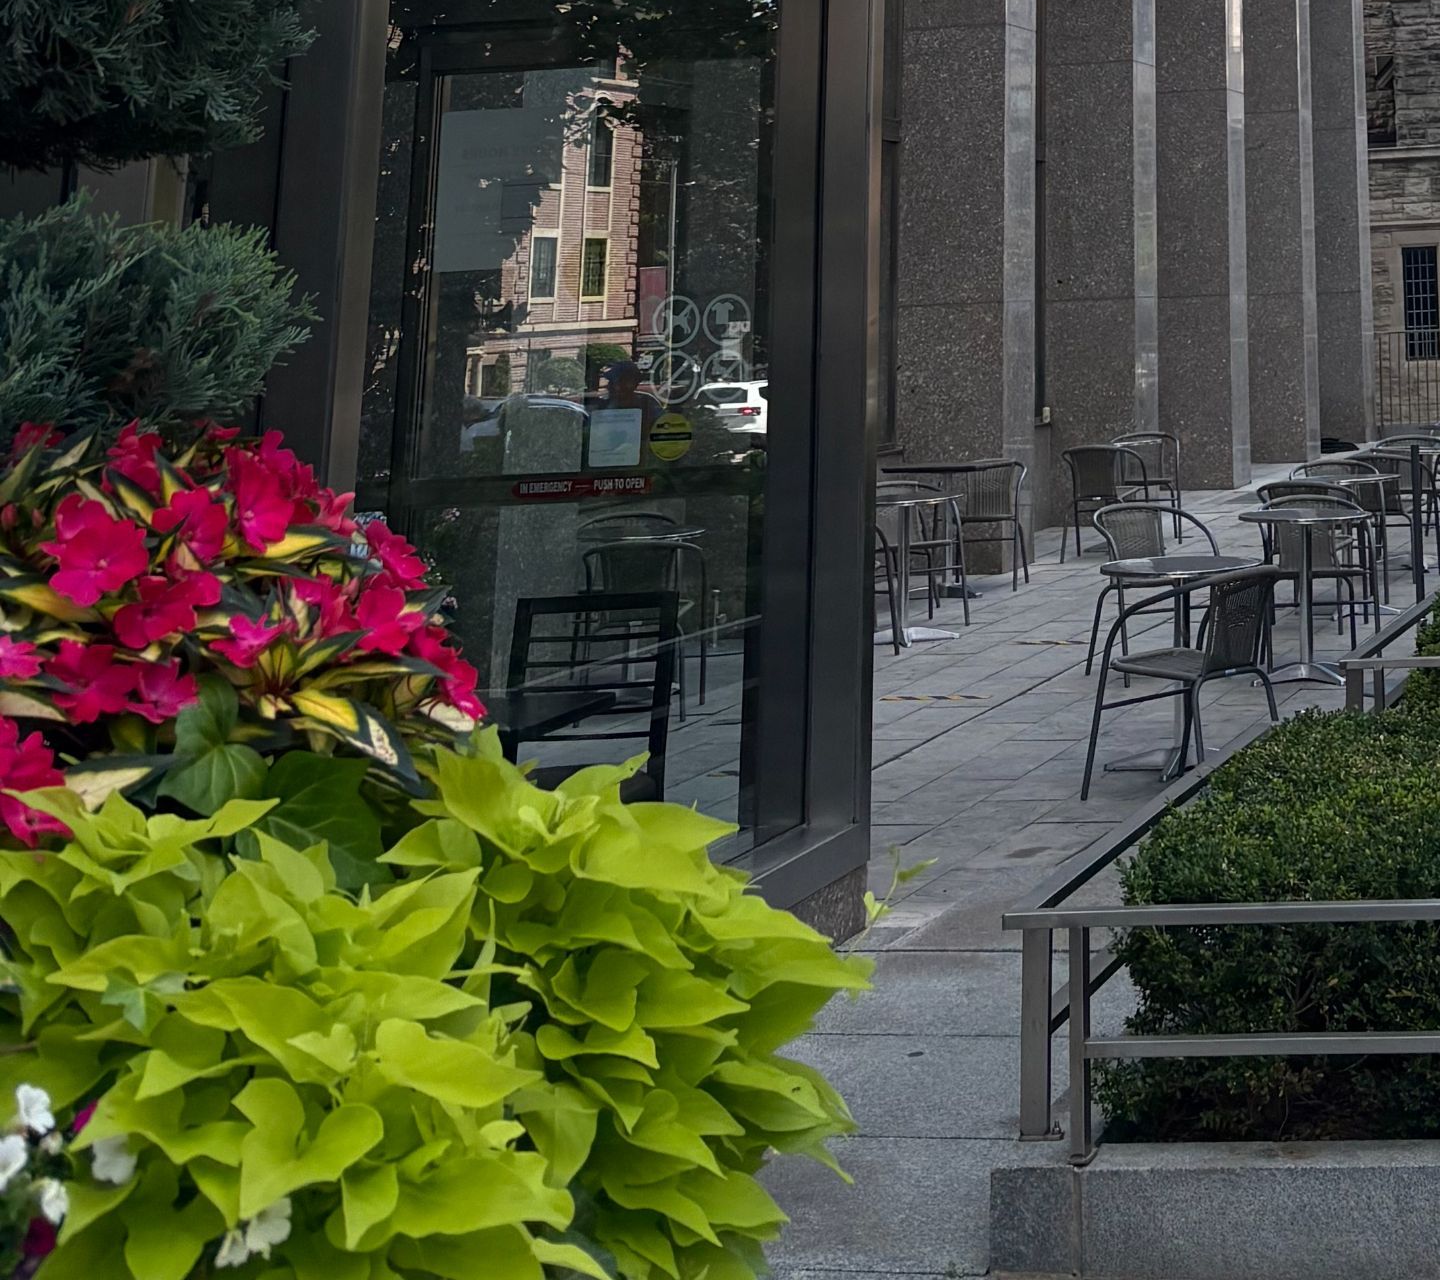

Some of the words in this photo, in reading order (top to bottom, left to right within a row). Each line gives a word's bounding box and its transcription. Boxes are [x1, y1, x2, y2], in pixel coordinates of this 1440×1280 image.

[529, 481, 573, 494] EMERGENCY
[593, 479, 613, 490] PUSH
[615, 479, 624, 489] TO
[625, 478, 645, 489] OPEN
